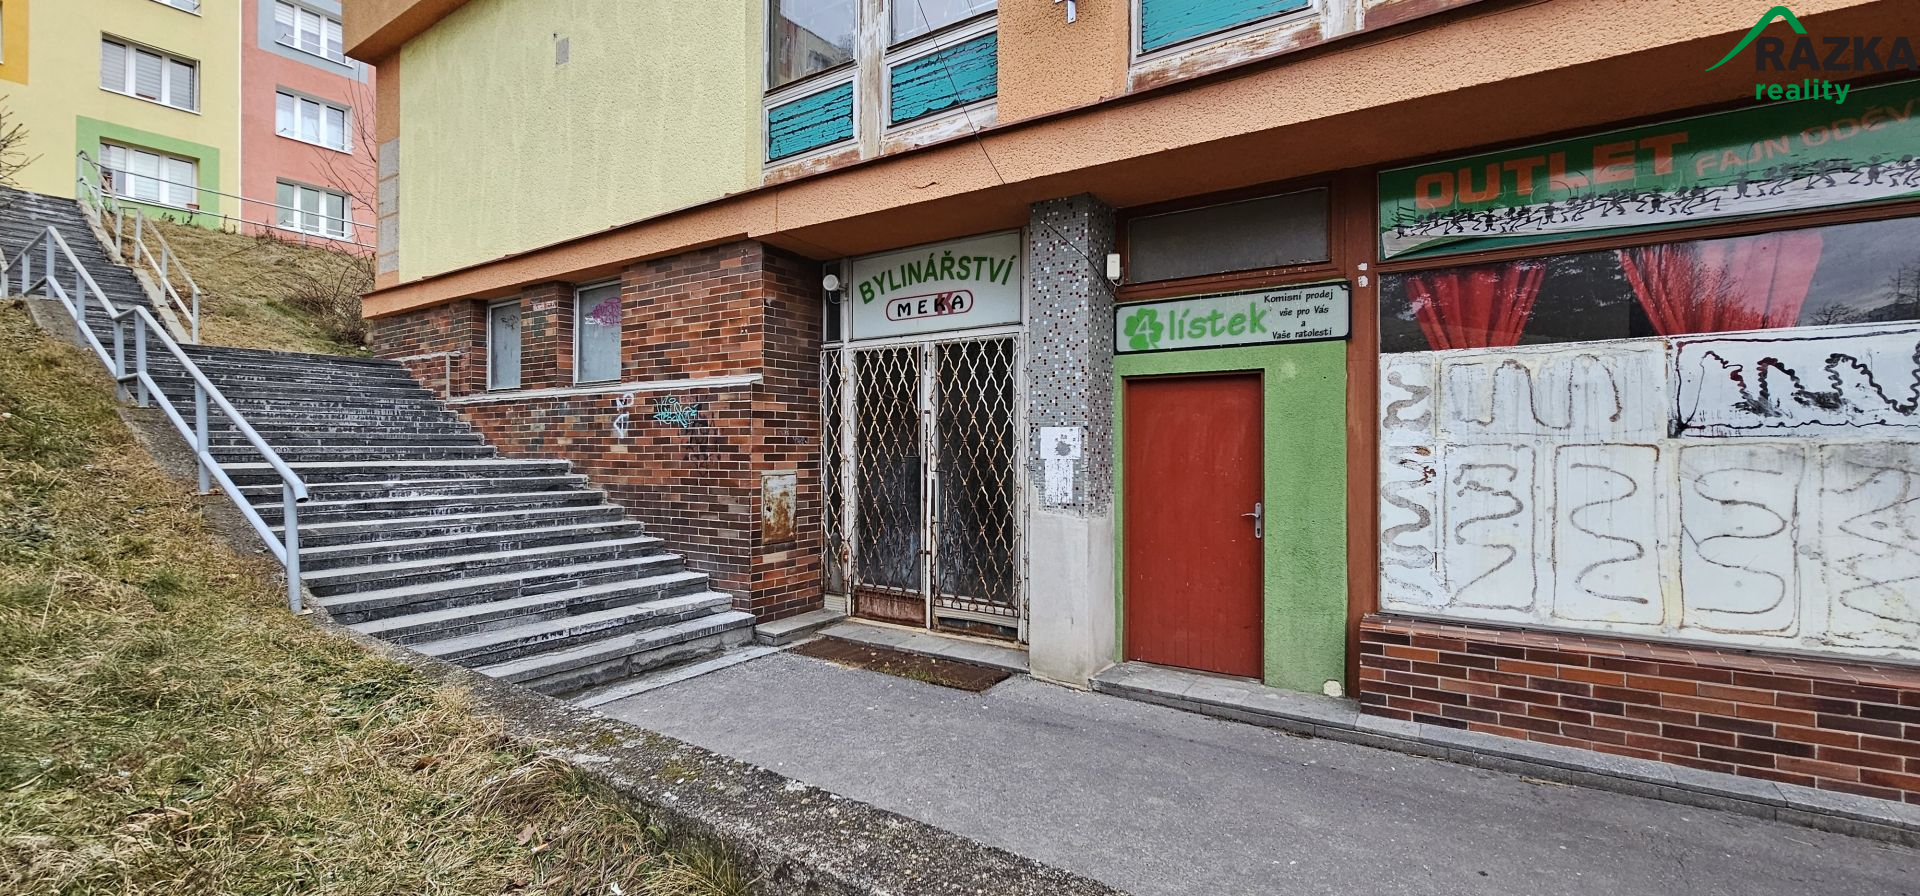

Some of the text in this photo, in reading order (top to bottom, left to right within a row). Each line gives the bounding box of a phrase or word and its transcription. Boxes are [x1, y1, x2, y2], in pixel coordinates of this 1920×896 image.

[1695, 97, 1920, 177] FAJN ODĚV
[1415, 131, 1688, 209] OUTLET
[858, 251, 1017, 305] BYLINÁŘSTVÍ
[897, 292, 964, 317] MEKA
[1264, 289, 1334, 303] Komisní prodej
[1279, 304, 1329, 318] vše pro Vás
[1272, 330, 1291, 340] Vaše
